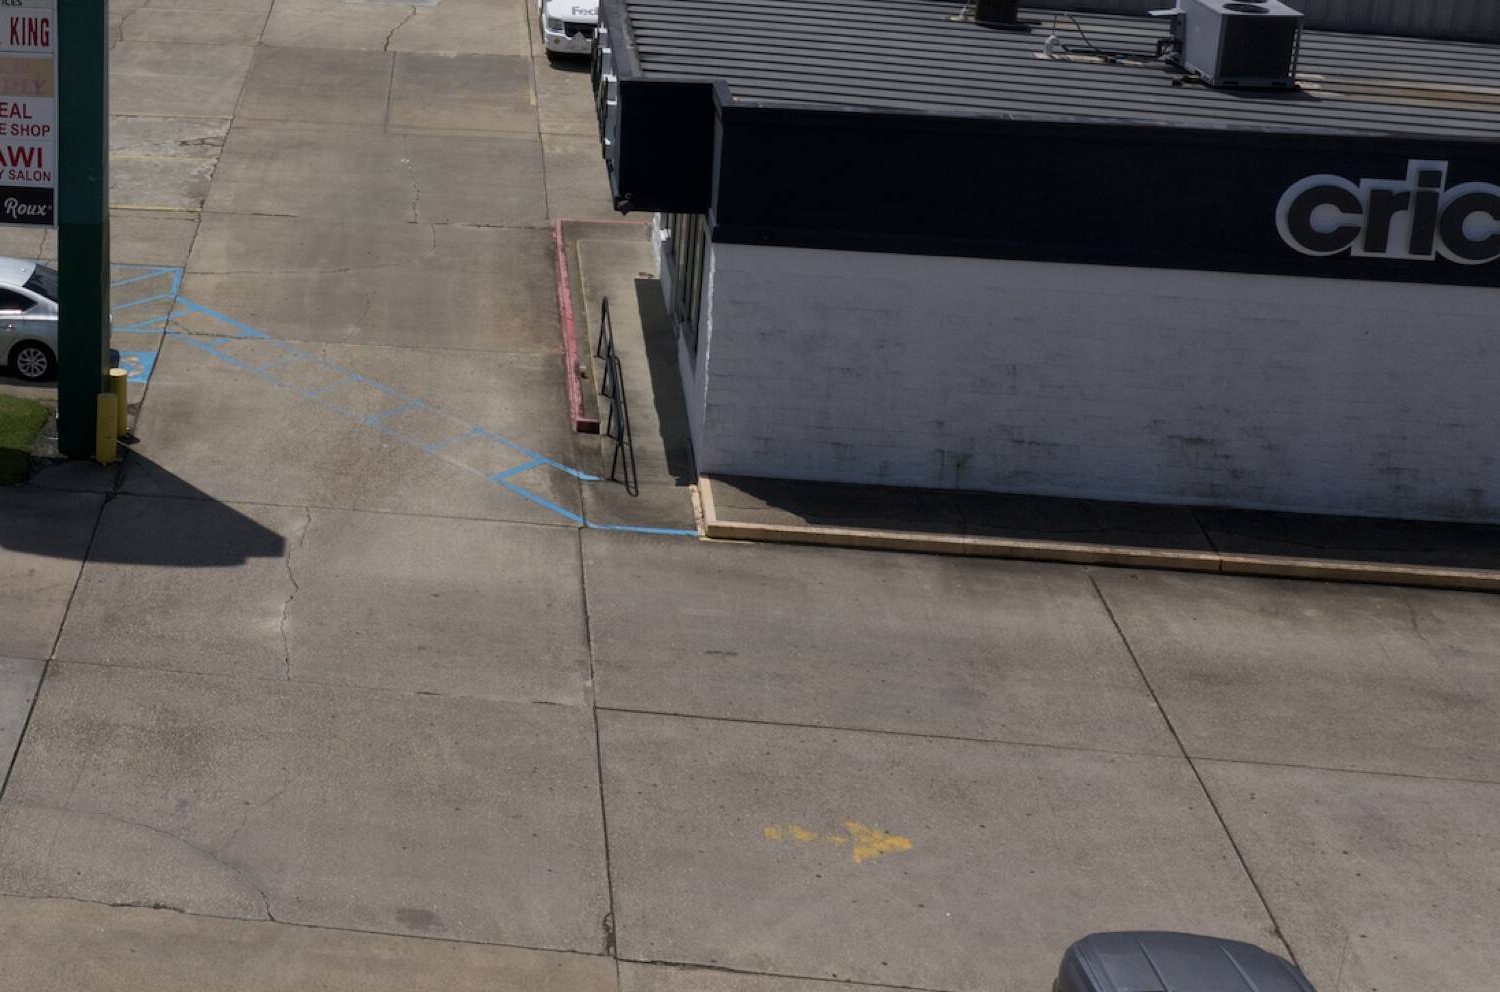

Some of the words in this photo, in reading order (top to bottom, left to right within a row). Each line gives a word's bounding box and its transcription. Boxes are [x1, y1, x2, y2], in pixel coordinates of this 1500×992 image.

[10, 16, 50, 47] KING
[10, 123, 50, 137] SHOP
[8, 169, 52, 182] SALON
[4, 196, 48, 220] Roux
[1275, 159, 1500, 265] cric
